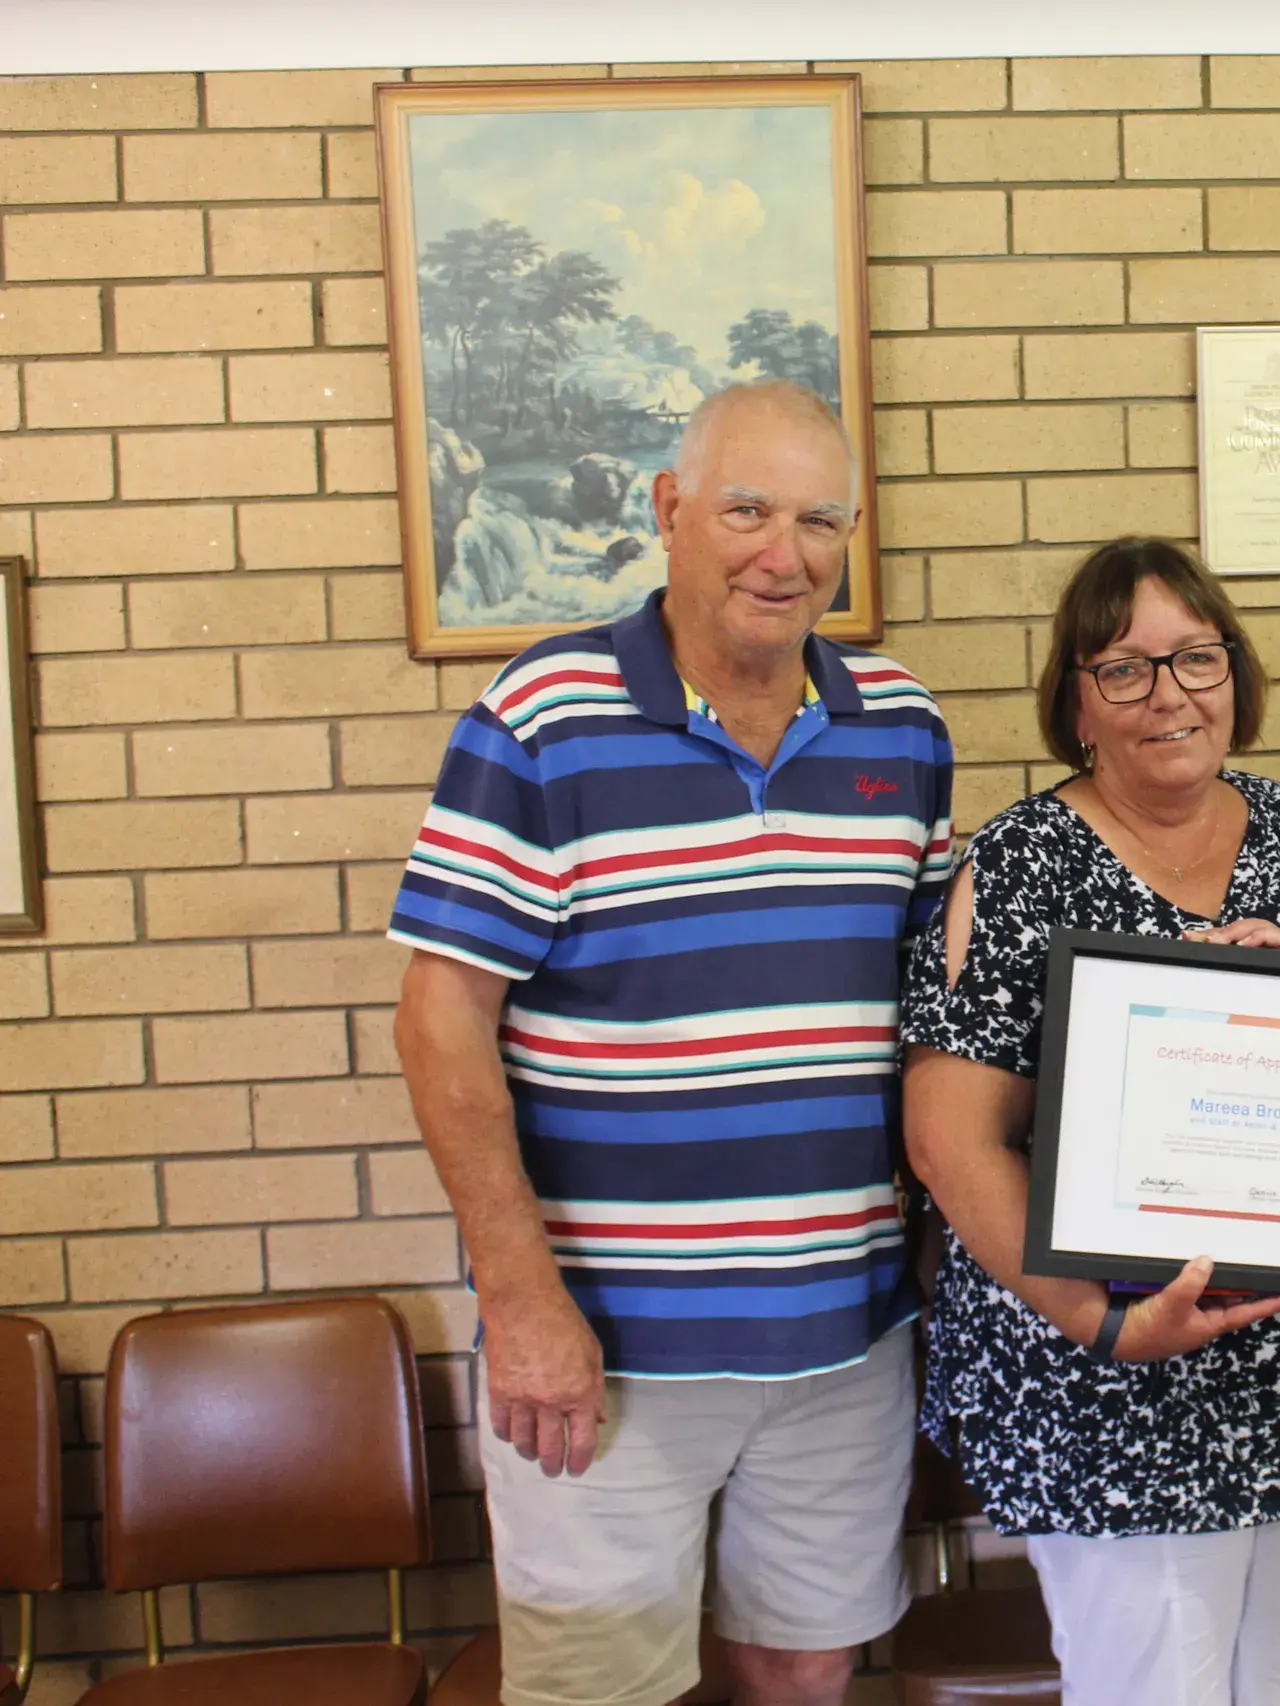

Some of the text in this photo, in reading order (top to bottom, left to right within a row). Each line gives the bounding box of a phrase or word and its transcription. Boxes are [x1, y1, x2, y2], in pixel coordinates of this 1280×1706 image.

[1157, 1046, 1233, 1065] Certificate
[1236, 1052, 1253, 1070] of
[1190, 1098, 1250, 1116] Mareea
